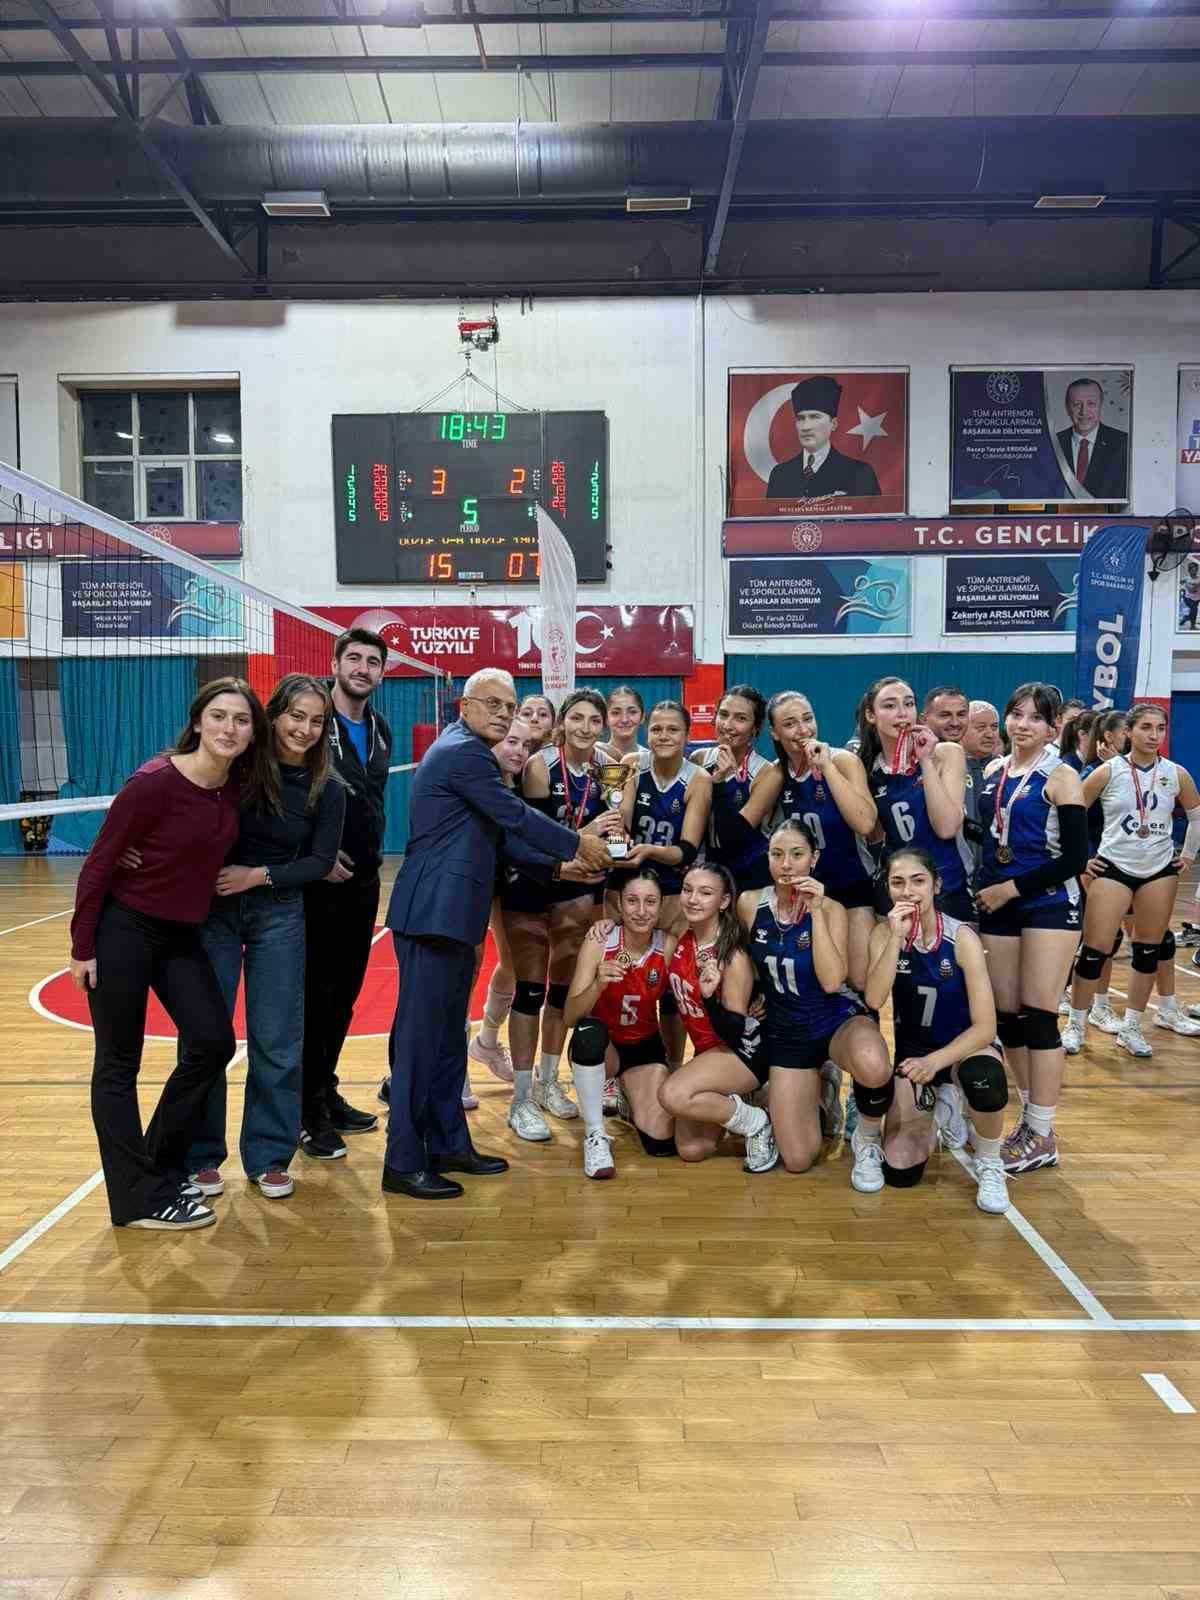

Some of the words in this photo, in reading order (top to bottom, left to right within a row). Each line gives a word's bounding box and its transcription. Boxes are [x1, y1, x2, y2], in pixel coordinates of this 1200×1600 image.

[962, 418, 974, 426] VE
[975, 418, 1042, 426] SPORCULARIMIZA
[972, 408, 990, 418] TÜM
[992, 408, 1034, 418] ANTRENÖR
[441, 414, 506, 440] 18:43
[431, 469, 447, 495] 3
[509, 469, 525, 494] 2
[462, 499, 478, 525] 5
[914, 526, 964, 545] T.C.
[429, 553, 453, 578] 15
[508, 552, 542, 578] 07
[81, 580, 98, 590] TÜM
[100, 580, 144, 590] ANTRENÖR
[750, 578, 767, 588] TÜM
[769, 578, 813, 587] ANTRENÖR
[956, 585, 967, 593] VE
[968, 584, 1040, 593] SPORCULARIMIZA
[966, 575, 985, 585] TÜM
[986, 575, 1031, 584] ANTRENÖR
[72, 590, 81, 598] VE
[739, 588, 751, 596] VE
[752, 587, 822, 596] SPORCULARIMIZA
[956, 594, 997, 602] BAŞARILAR
[998, 593, 1040, 601] DİLİYORUM
[739, 598, 779, 606] BAŞARILAR
[780, 597, 821, 605] DİLİYORUM
[952, 611, 988, 621] Zekeriya
[989, 608, 1050, 619] ARSLANTÜRK
[635, 815, 676, 847] 33
[890, 801, 916, 842] 6
[763, 955, 800, 996] 11
[620, 994, 641, 1026] 5
[917, 985, 938, 1027] 7
